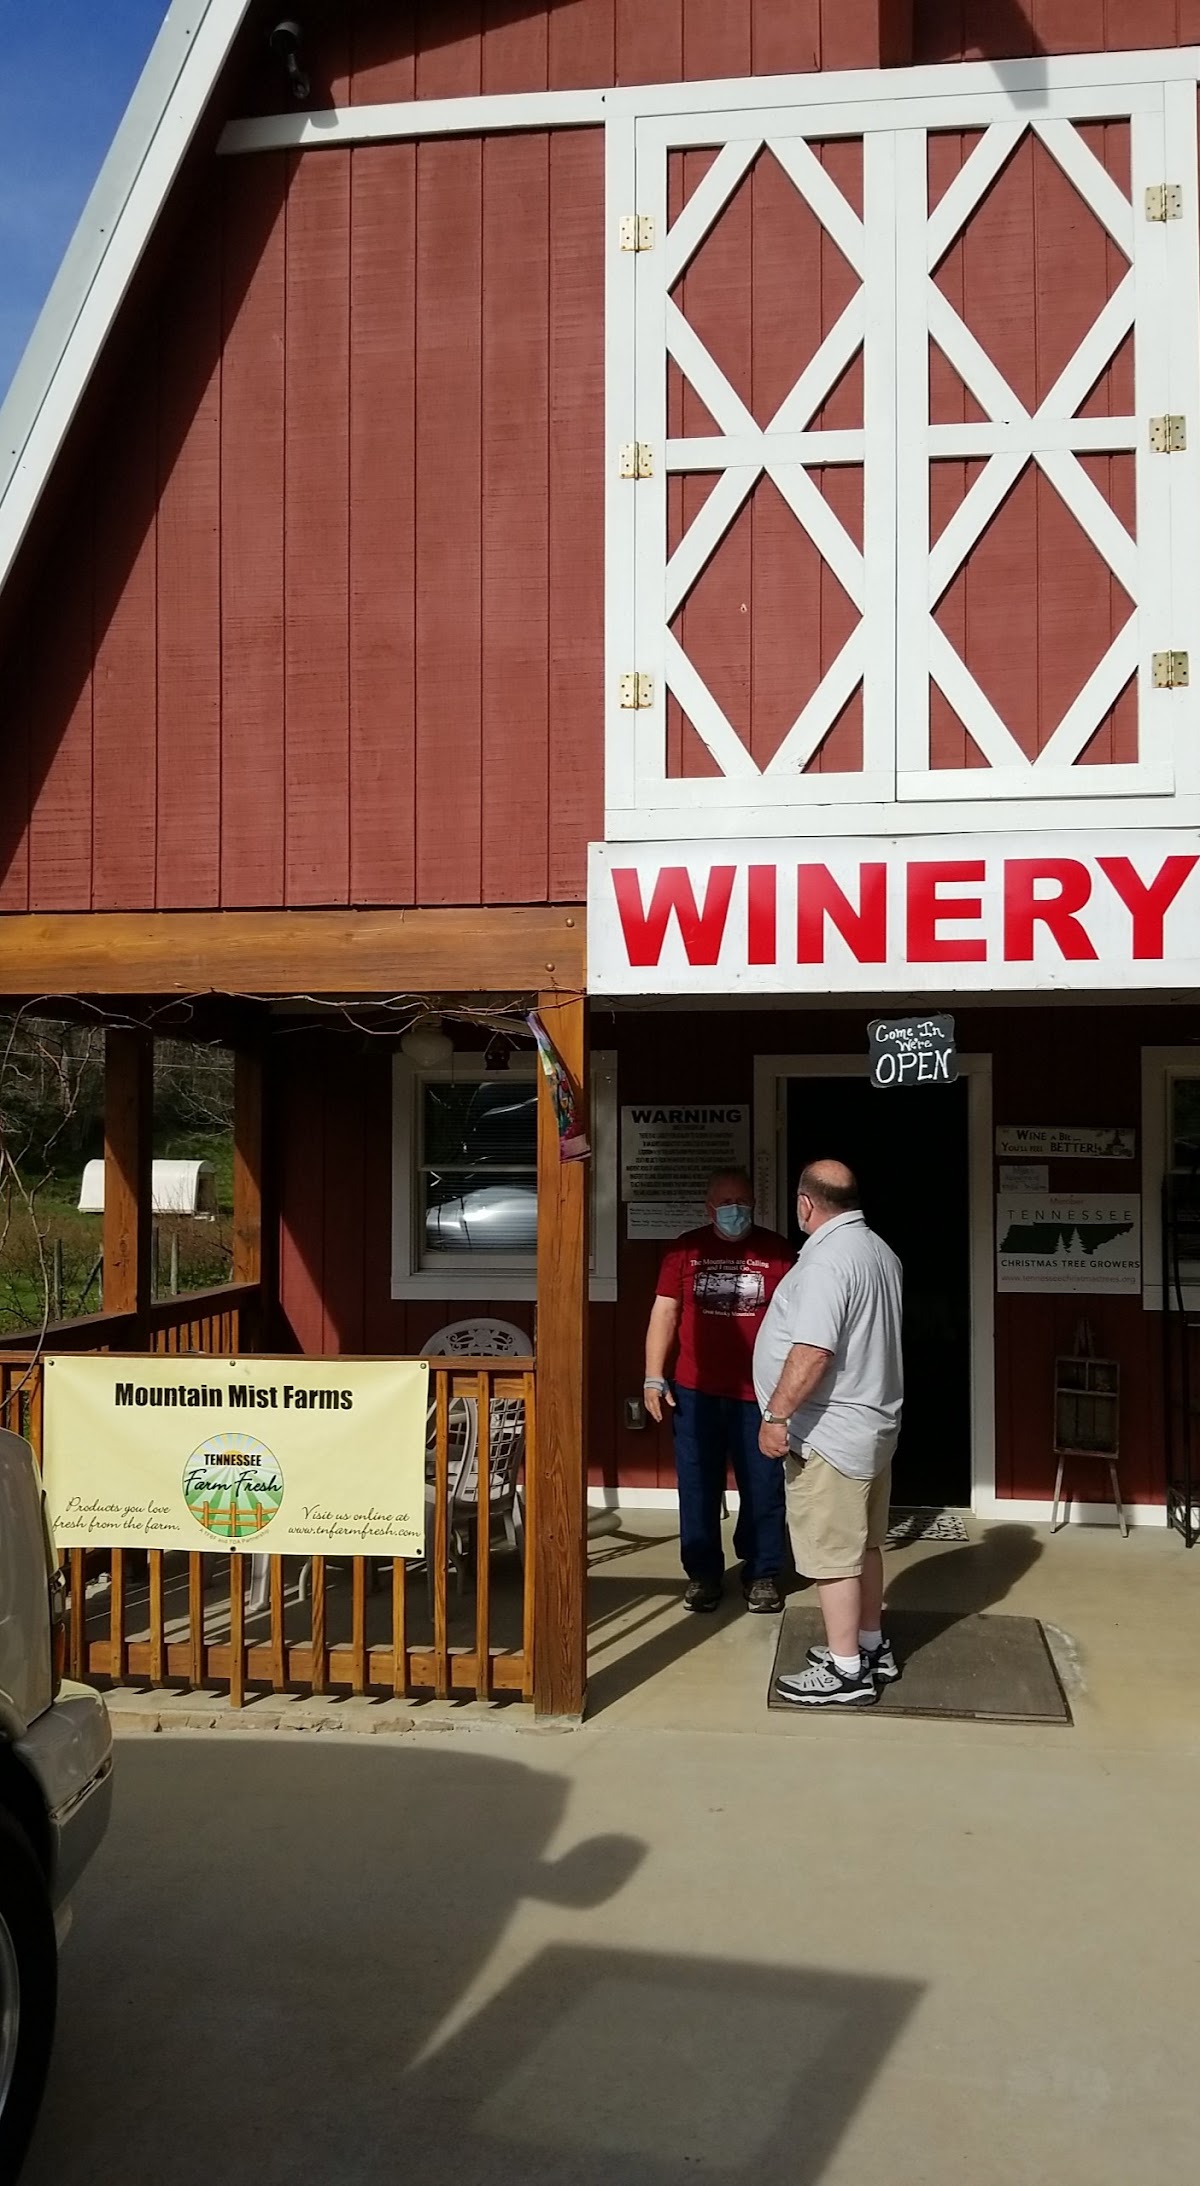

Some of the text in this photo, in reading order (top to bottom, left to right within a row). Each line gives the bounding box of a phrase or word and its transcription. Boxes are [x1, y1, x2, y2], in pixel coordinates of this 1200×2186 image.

[611, 855, 1200, 966] WINERY
[875, 1021, 945, 1042] Come In
[895, 1038, 933, 1051] We're
[875, 1048, 952, 1083] OPEN
[631, 1109, 742, 1124] WARNING
[1050, 1143, 1097, 1153] BETTER!
[1007, 1209, 1133, 1221] TENNESSEE
[746, 1259, 770, 1269] Calling
[1001, 1259, 1140, 1268] CHRISTMAS TREE GROWERS
[115, 1383, 353, 1410] Mountain Mist Farms
[204, 1454, 262, 1466] TENNESSEE
[184, 1468, 282, 1497] Farm Fresh
[65, 1496, 170, 1518] Products you love
[302, 1504, 410, 1522] Visit us online at
[52, 1515, 180, 1533] fresh from the farm.
[288, 1522, 421, 1539] www.tnfarmfresh.com
